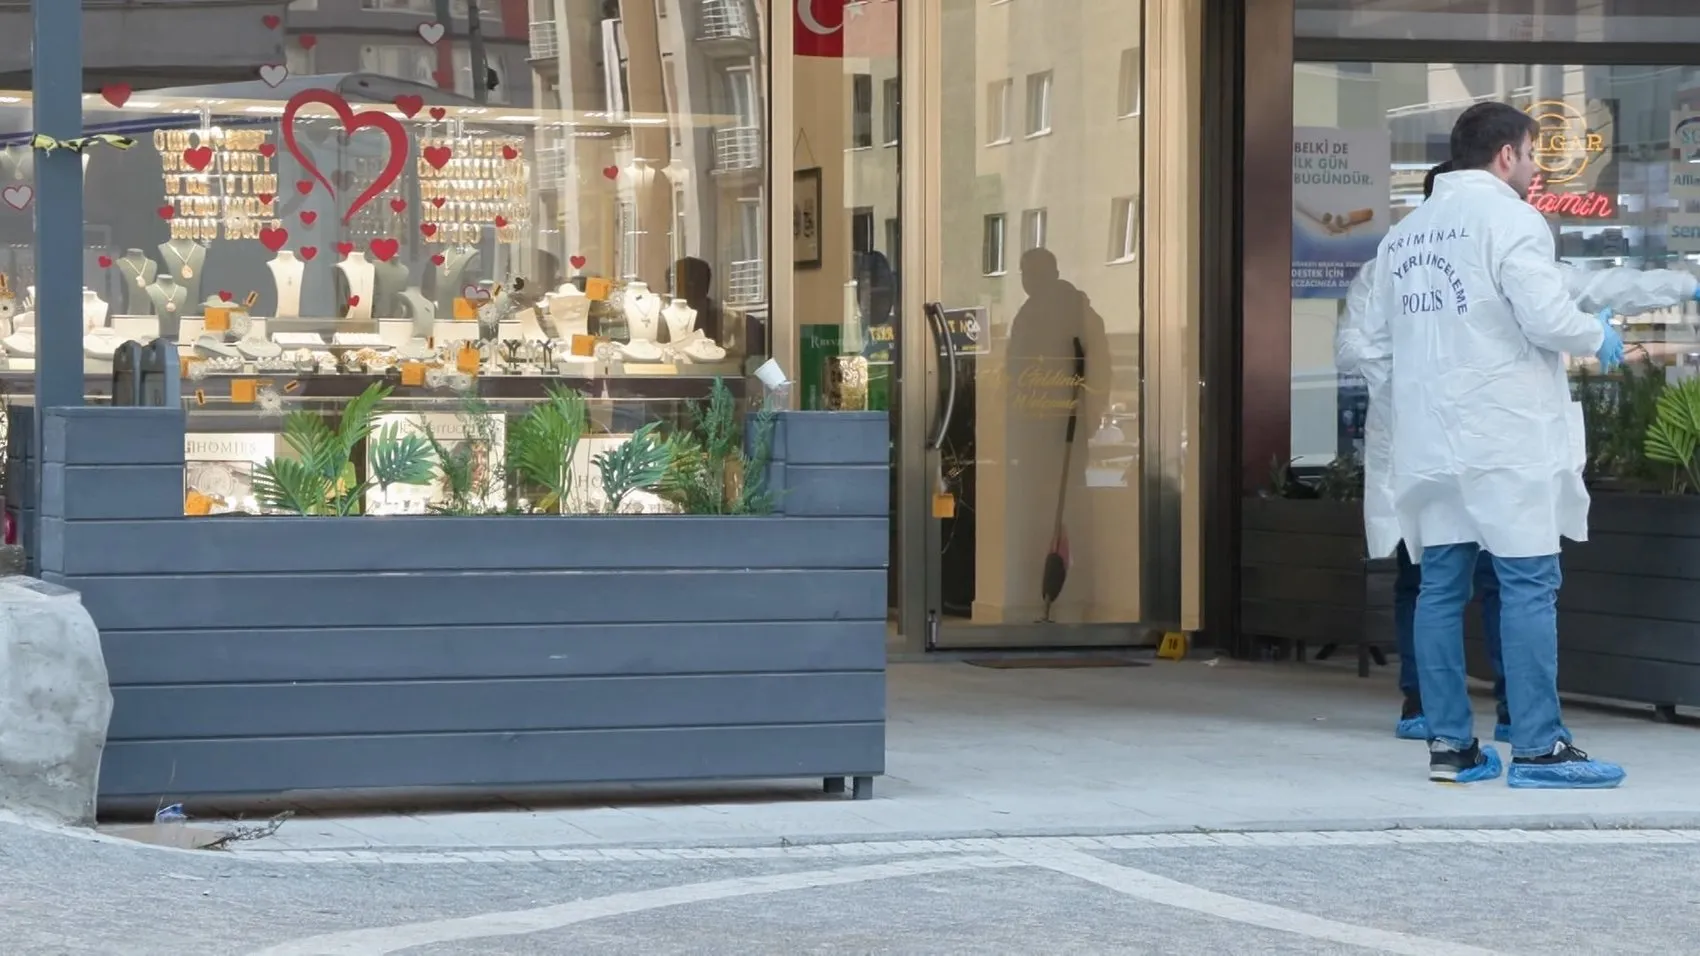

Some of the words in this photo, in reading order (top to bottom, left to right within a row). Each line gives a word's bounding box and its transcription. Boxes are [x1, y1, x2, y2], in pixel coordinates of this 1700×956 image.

[1294, 139, 1329, 154] BELKİ
[1333, 143, 1348, 154] DE
[1533, 132, 1605, 151] LGAR
[1318, 155, 1348, 169] GÜN
[1294, 170, 1374, 185] BUGÜNDÜR.
[1527, 174, 1613, 217] tamin
[1402, 285, 1443, 315] POLİS
